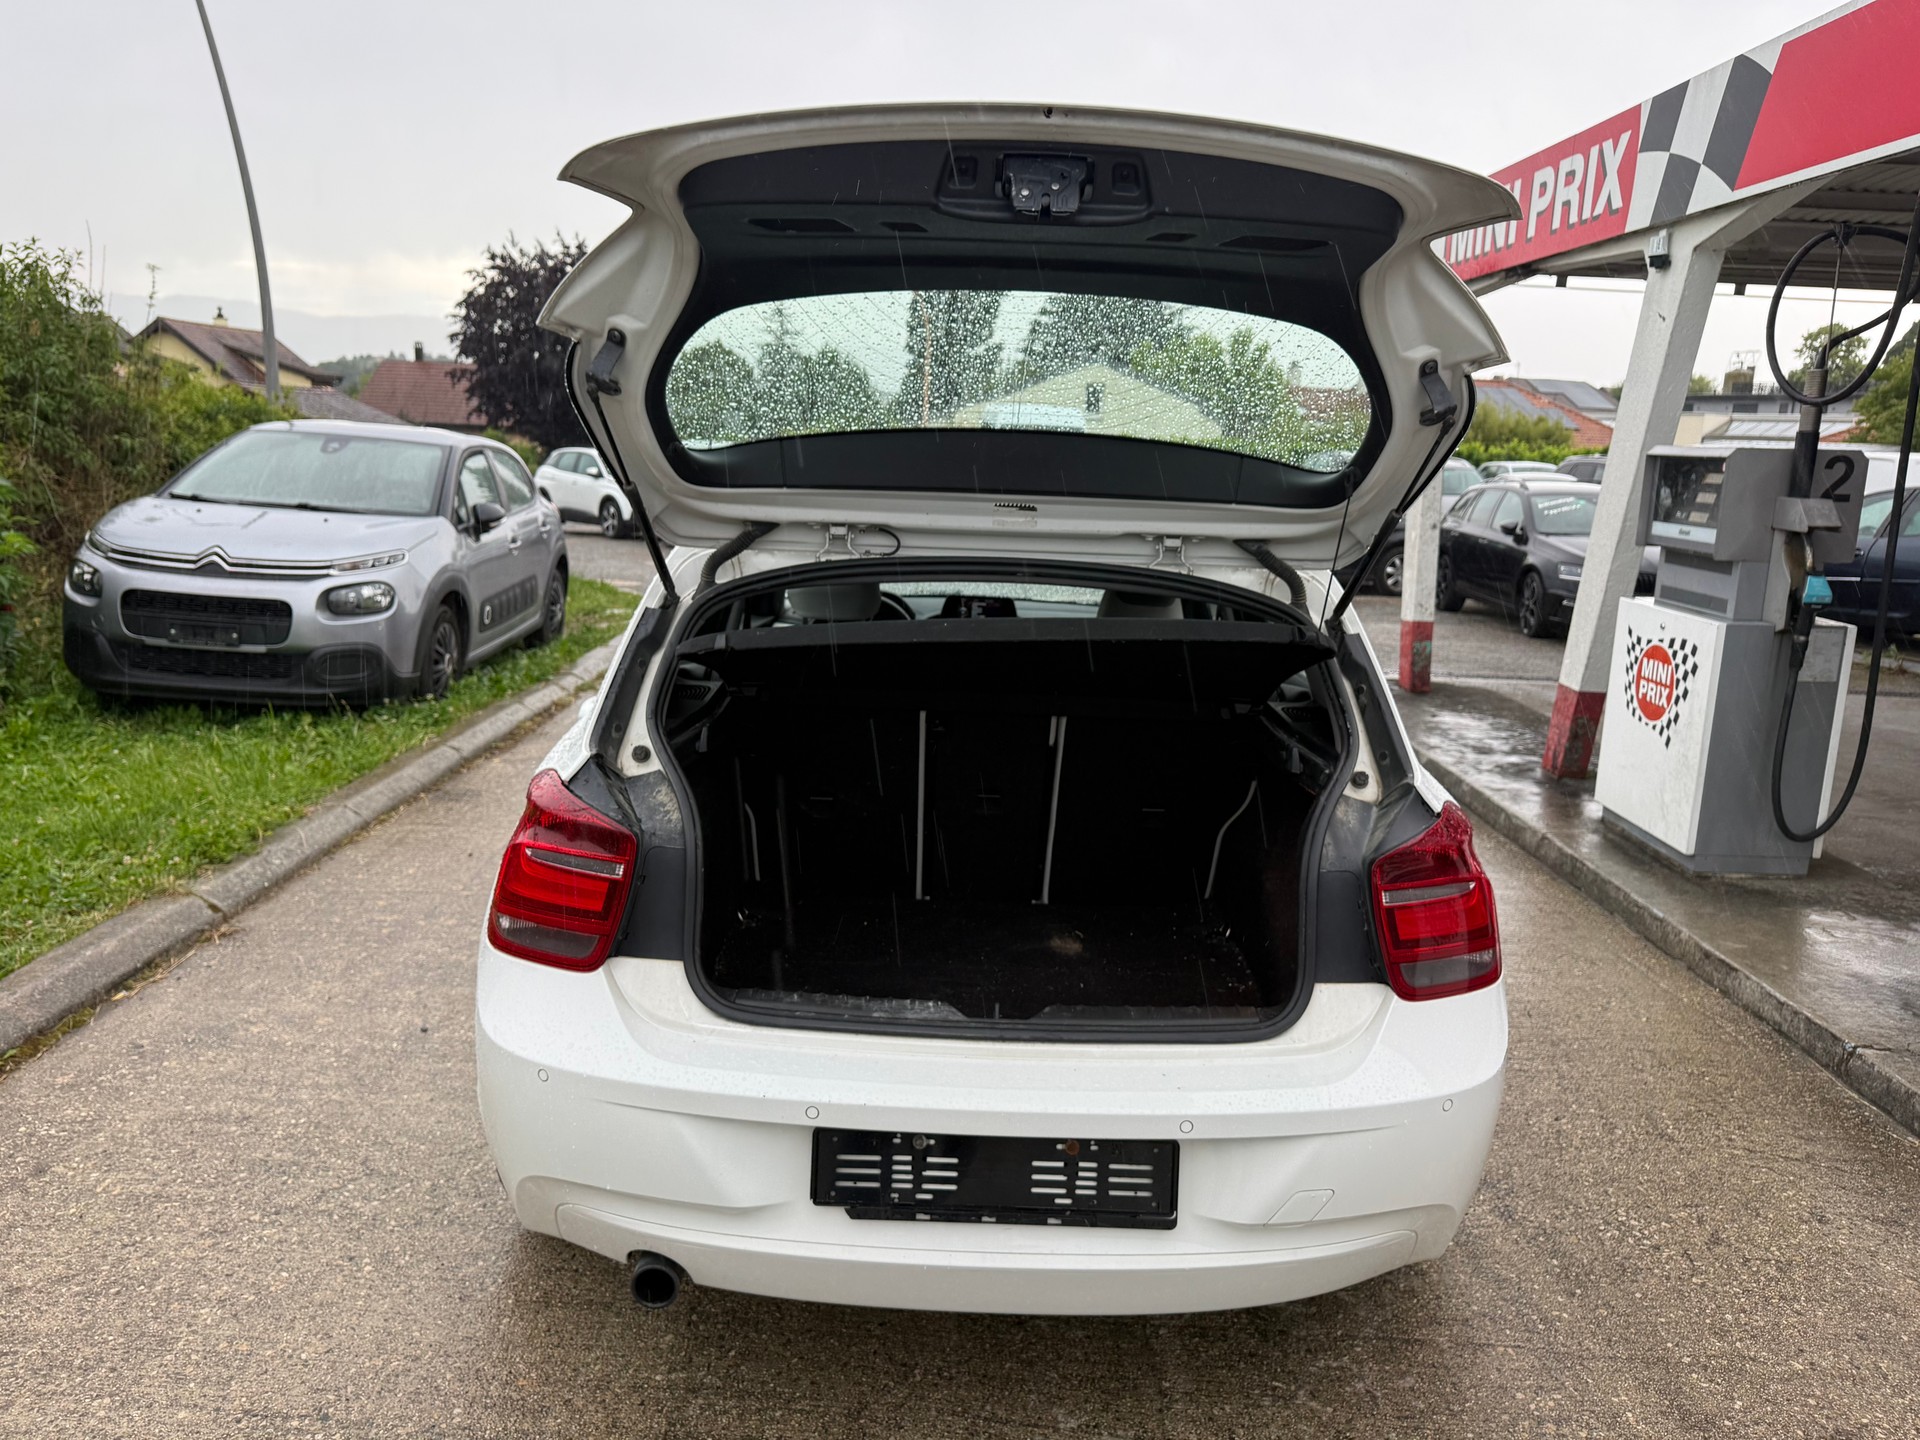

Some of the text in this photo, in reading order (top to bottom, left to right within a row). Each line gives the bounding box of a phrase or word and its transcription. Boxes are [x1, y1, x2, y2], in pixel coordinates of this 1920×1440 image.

[1527, 130, 1632, 240] PRIX
[1821, 455, 1855, 502] 2
[1641, 657, 1672, 687] MINI
[1638, 679, 1670, 709] PRIX
